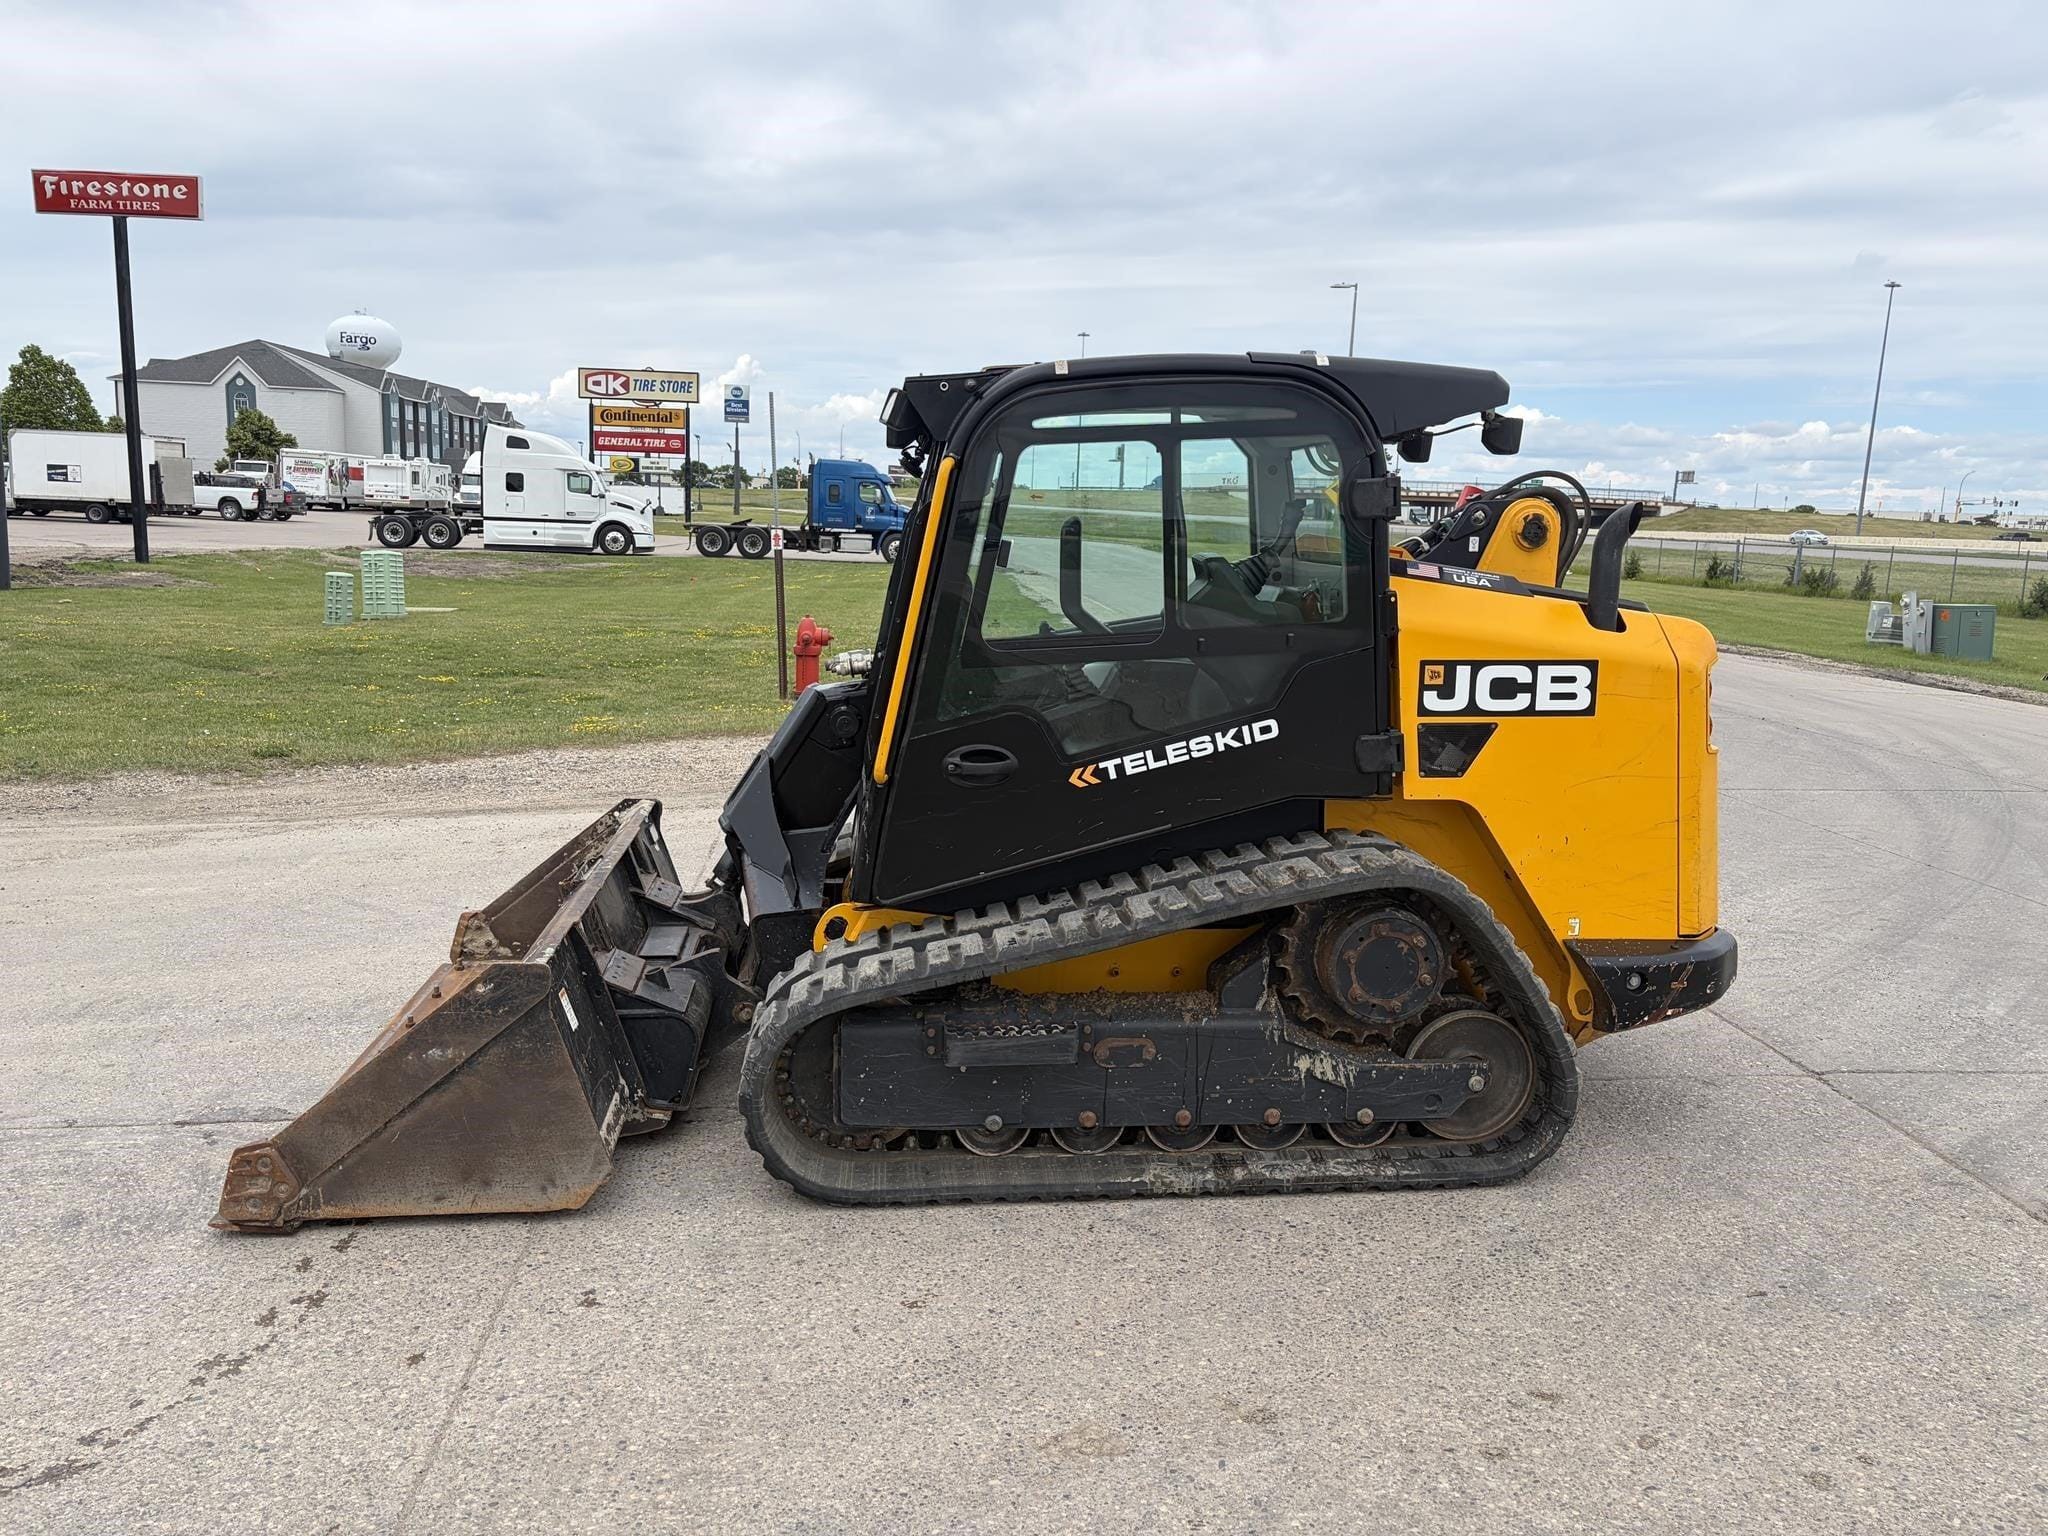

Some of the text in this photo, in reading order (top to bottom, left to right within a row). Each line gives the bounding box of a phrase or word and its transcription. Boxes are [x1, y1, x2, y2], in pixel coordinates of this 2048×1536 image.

[39, 175, 189, 200] Firestone
[70, 199, 160, 211] FARM TIRES
[339, 331, 377, 351] Fargo
[587, 374, 694, 395] OK TIRE STORE
[600, 408, 673, 423] Continental
[598, 436, 642, 447] GENERAL
[643, 438, 667, 448] TIRE
[1453, 574, 1492, 587] USA
[1424, 664, 1592, 712] JCB
[1098, 718, 1280, 780] TELESKID
